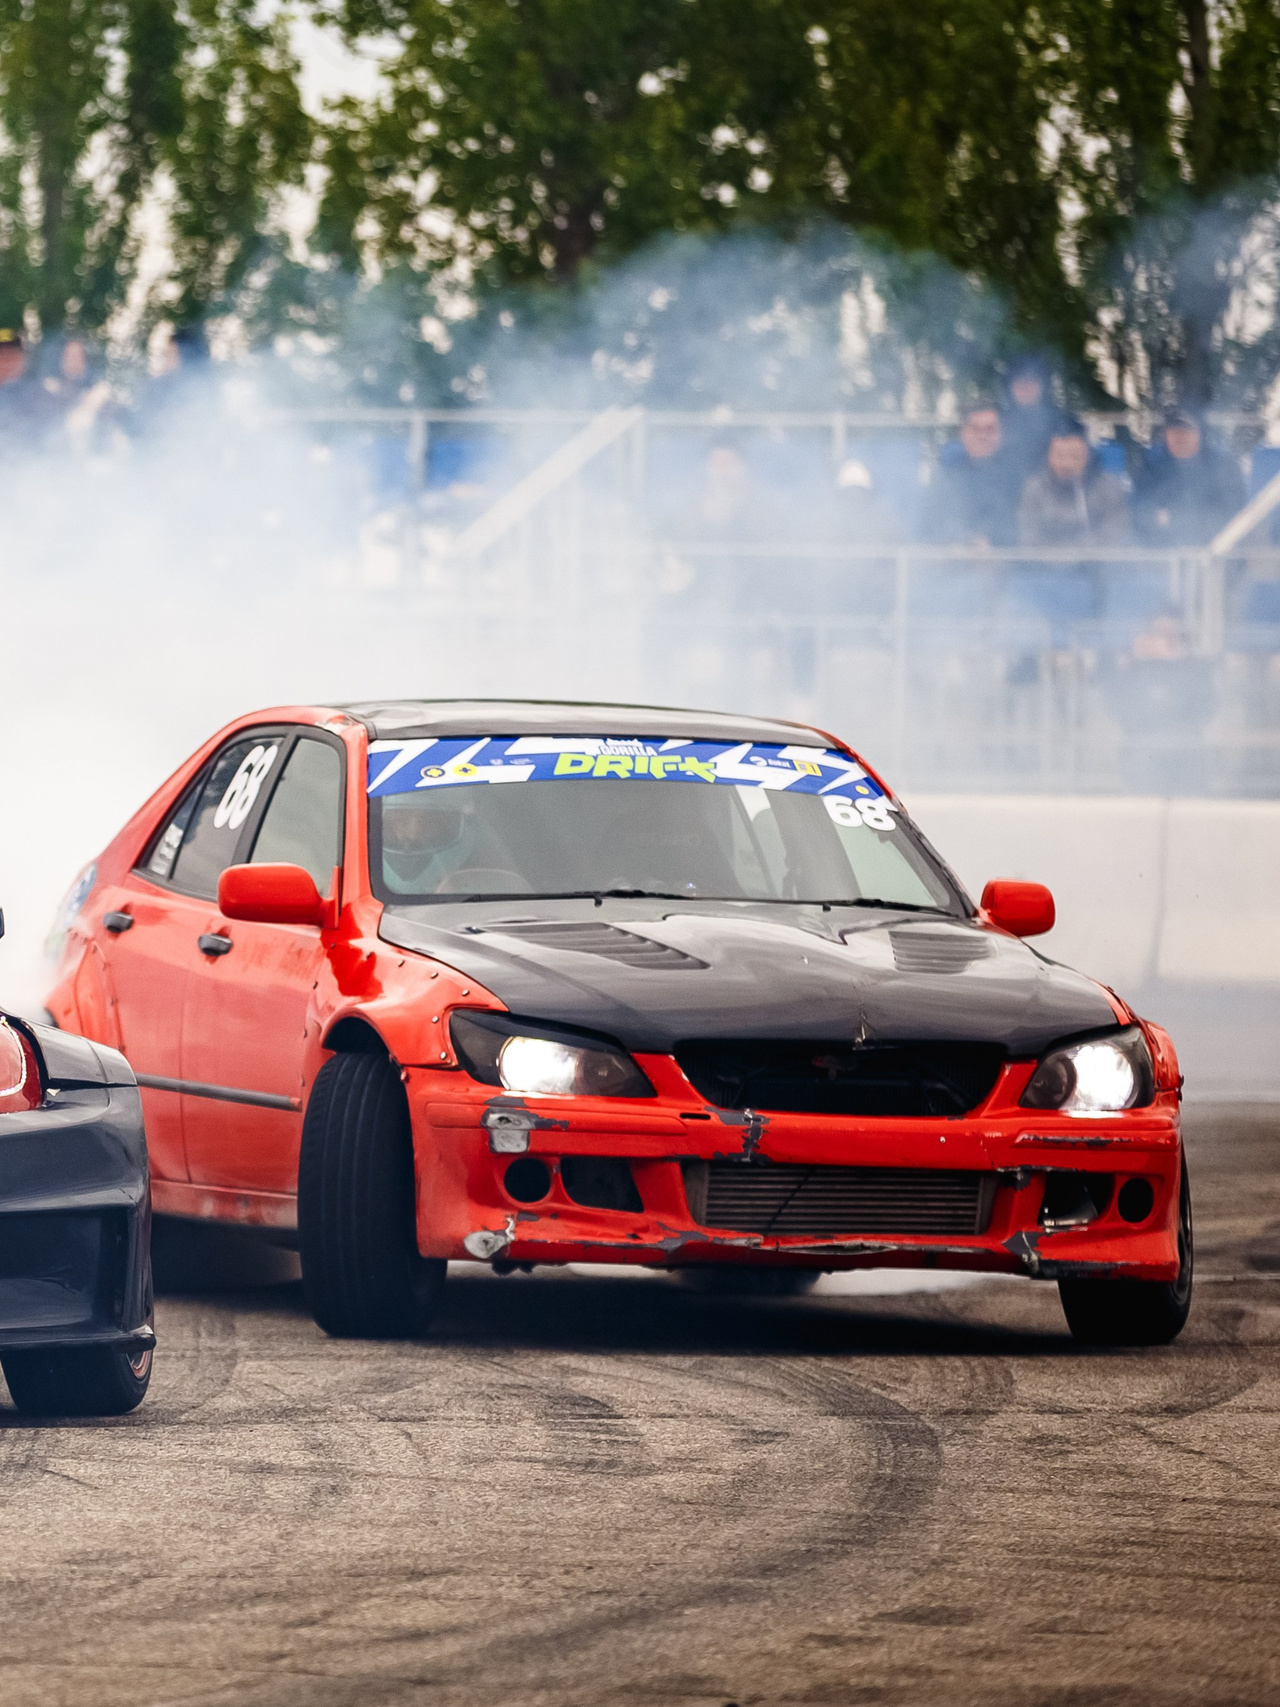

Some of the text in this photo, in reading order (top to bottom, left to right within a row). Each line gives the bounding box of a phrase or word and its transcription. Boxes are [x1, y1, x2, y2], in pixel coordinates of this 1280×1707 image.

[600, 745, 658, 757] GORILLA
[553, 753, 716, 784] DRIFT
[214, 745, 278, 829] 68
[823, 795, 896, 831] 68
